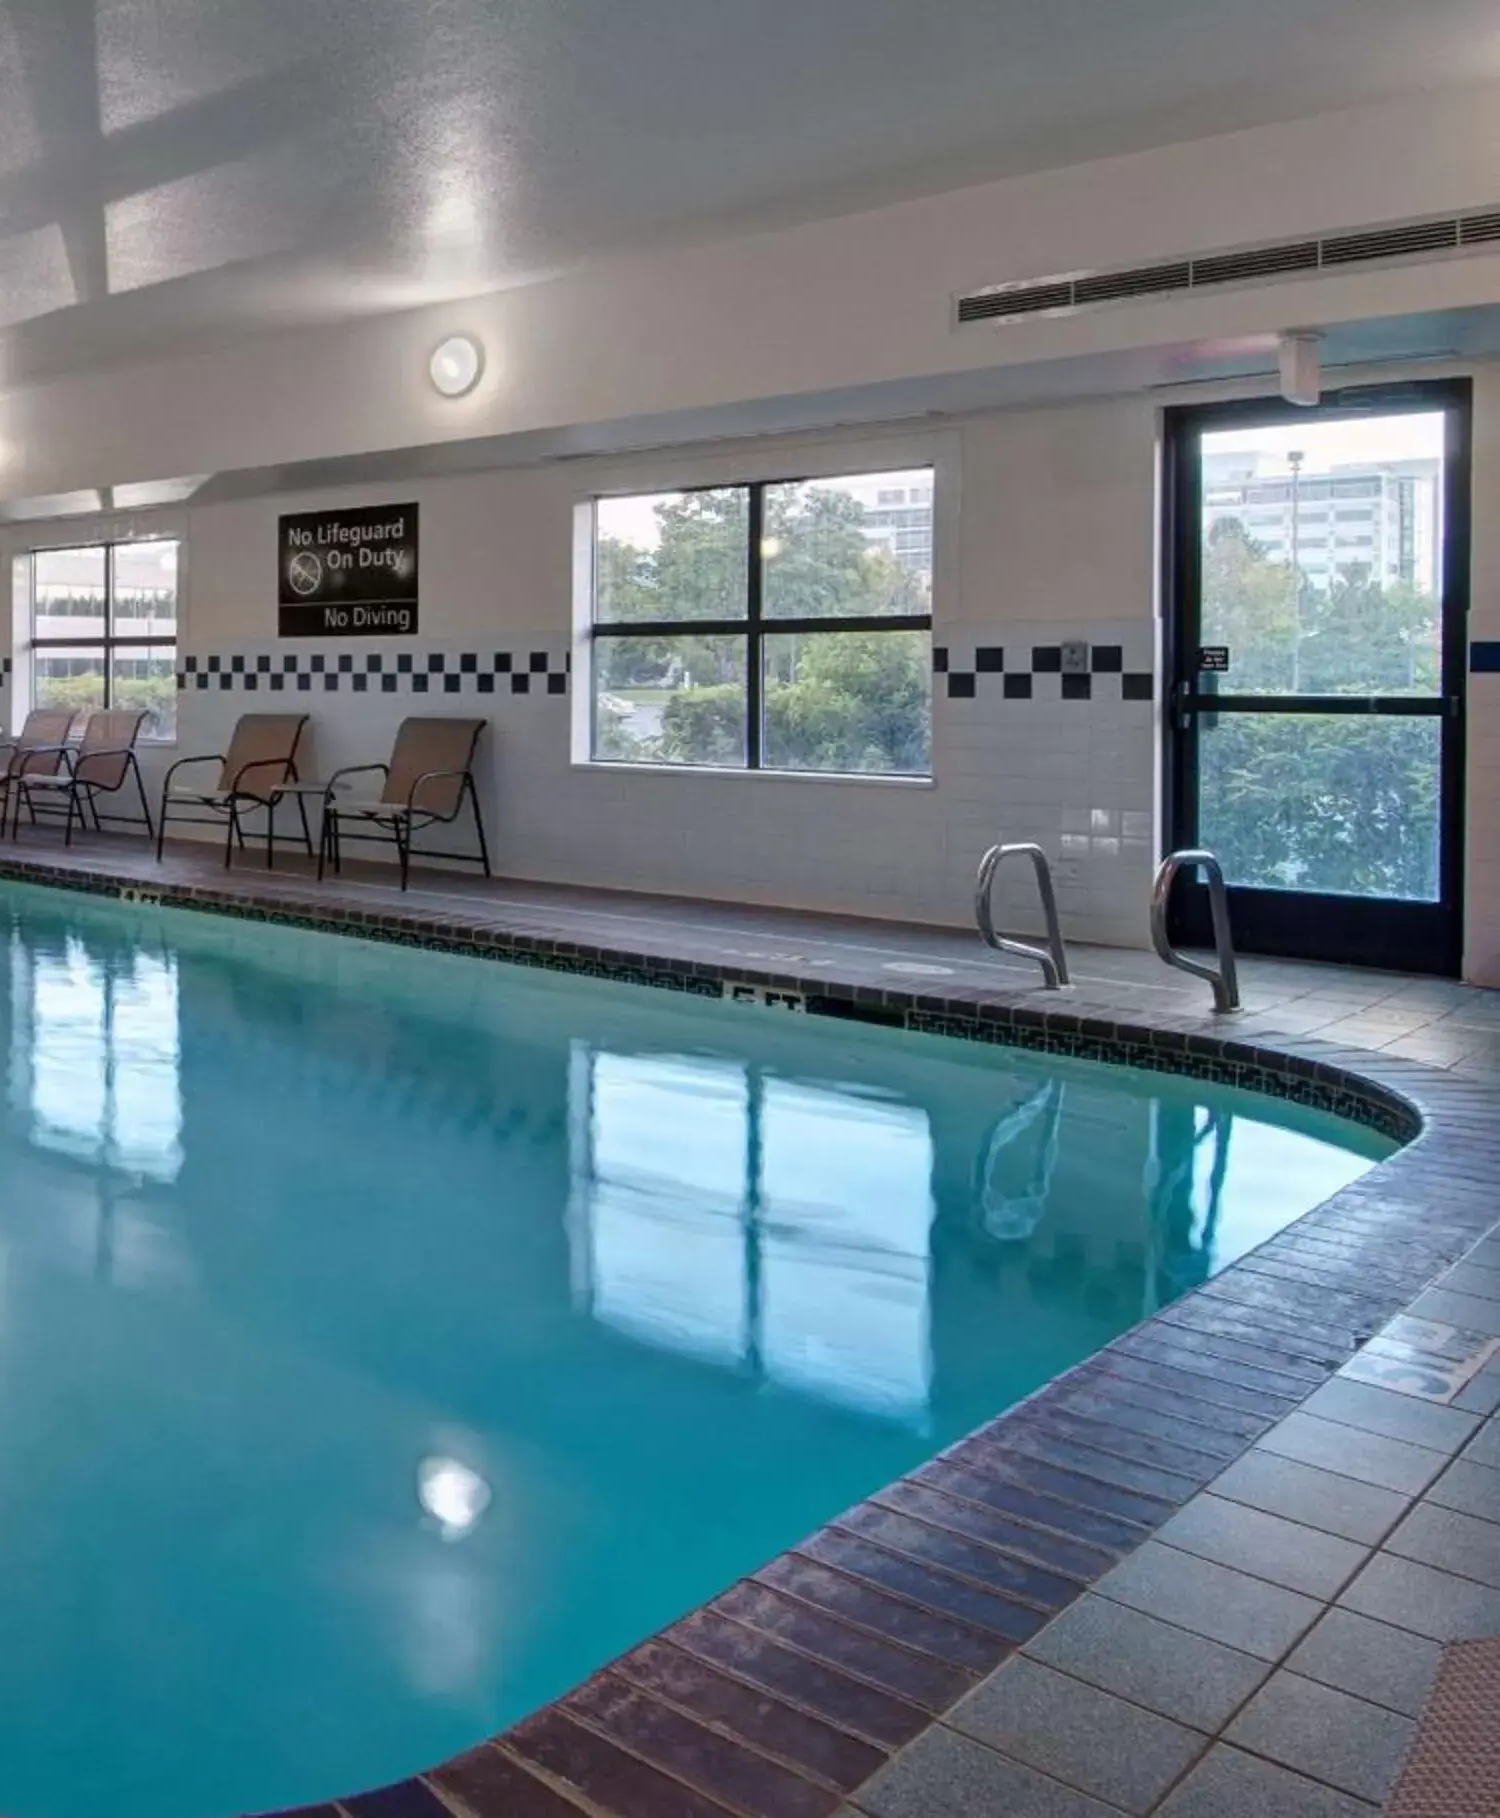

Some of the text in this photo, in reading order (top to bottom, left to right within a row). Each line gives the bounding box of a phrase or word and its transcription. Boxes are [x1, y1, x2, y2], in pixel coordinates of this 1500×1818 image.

[288, 517, 404, 546] No Lifeguard
[327, 548, 404, 572] On Duty
[324, 605, 410, 630] No Diving
